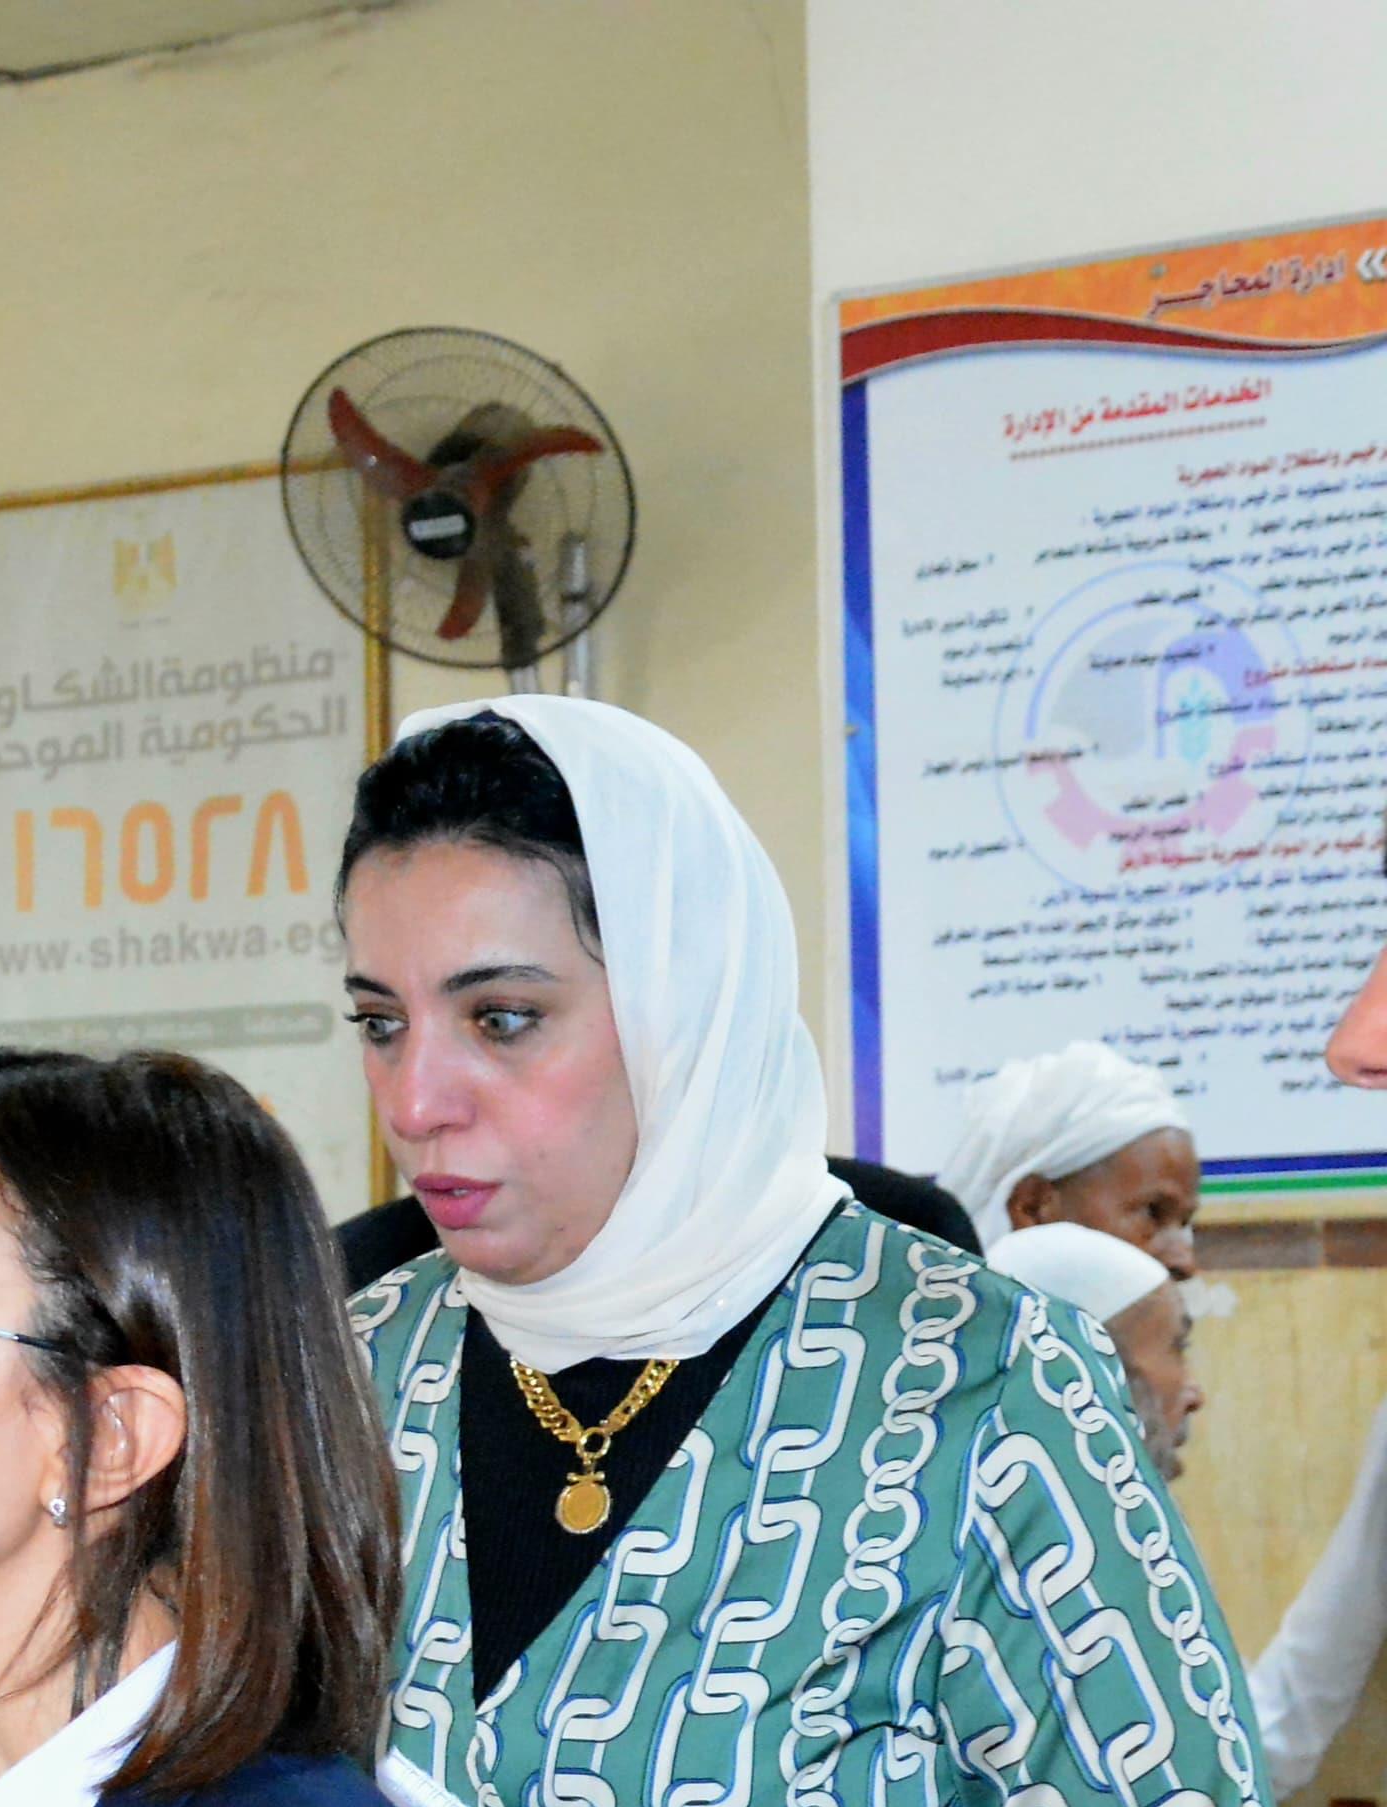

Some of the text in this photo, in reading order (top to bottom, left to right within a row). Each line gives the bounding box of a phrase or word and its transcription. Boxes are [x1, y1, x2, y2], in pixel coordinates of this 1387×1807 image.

[158, 641, 336, 705] منظومة
[139, 697, 348, 766] الحكومية
[14, 790, 309, 913] ١٦٥٢٨
